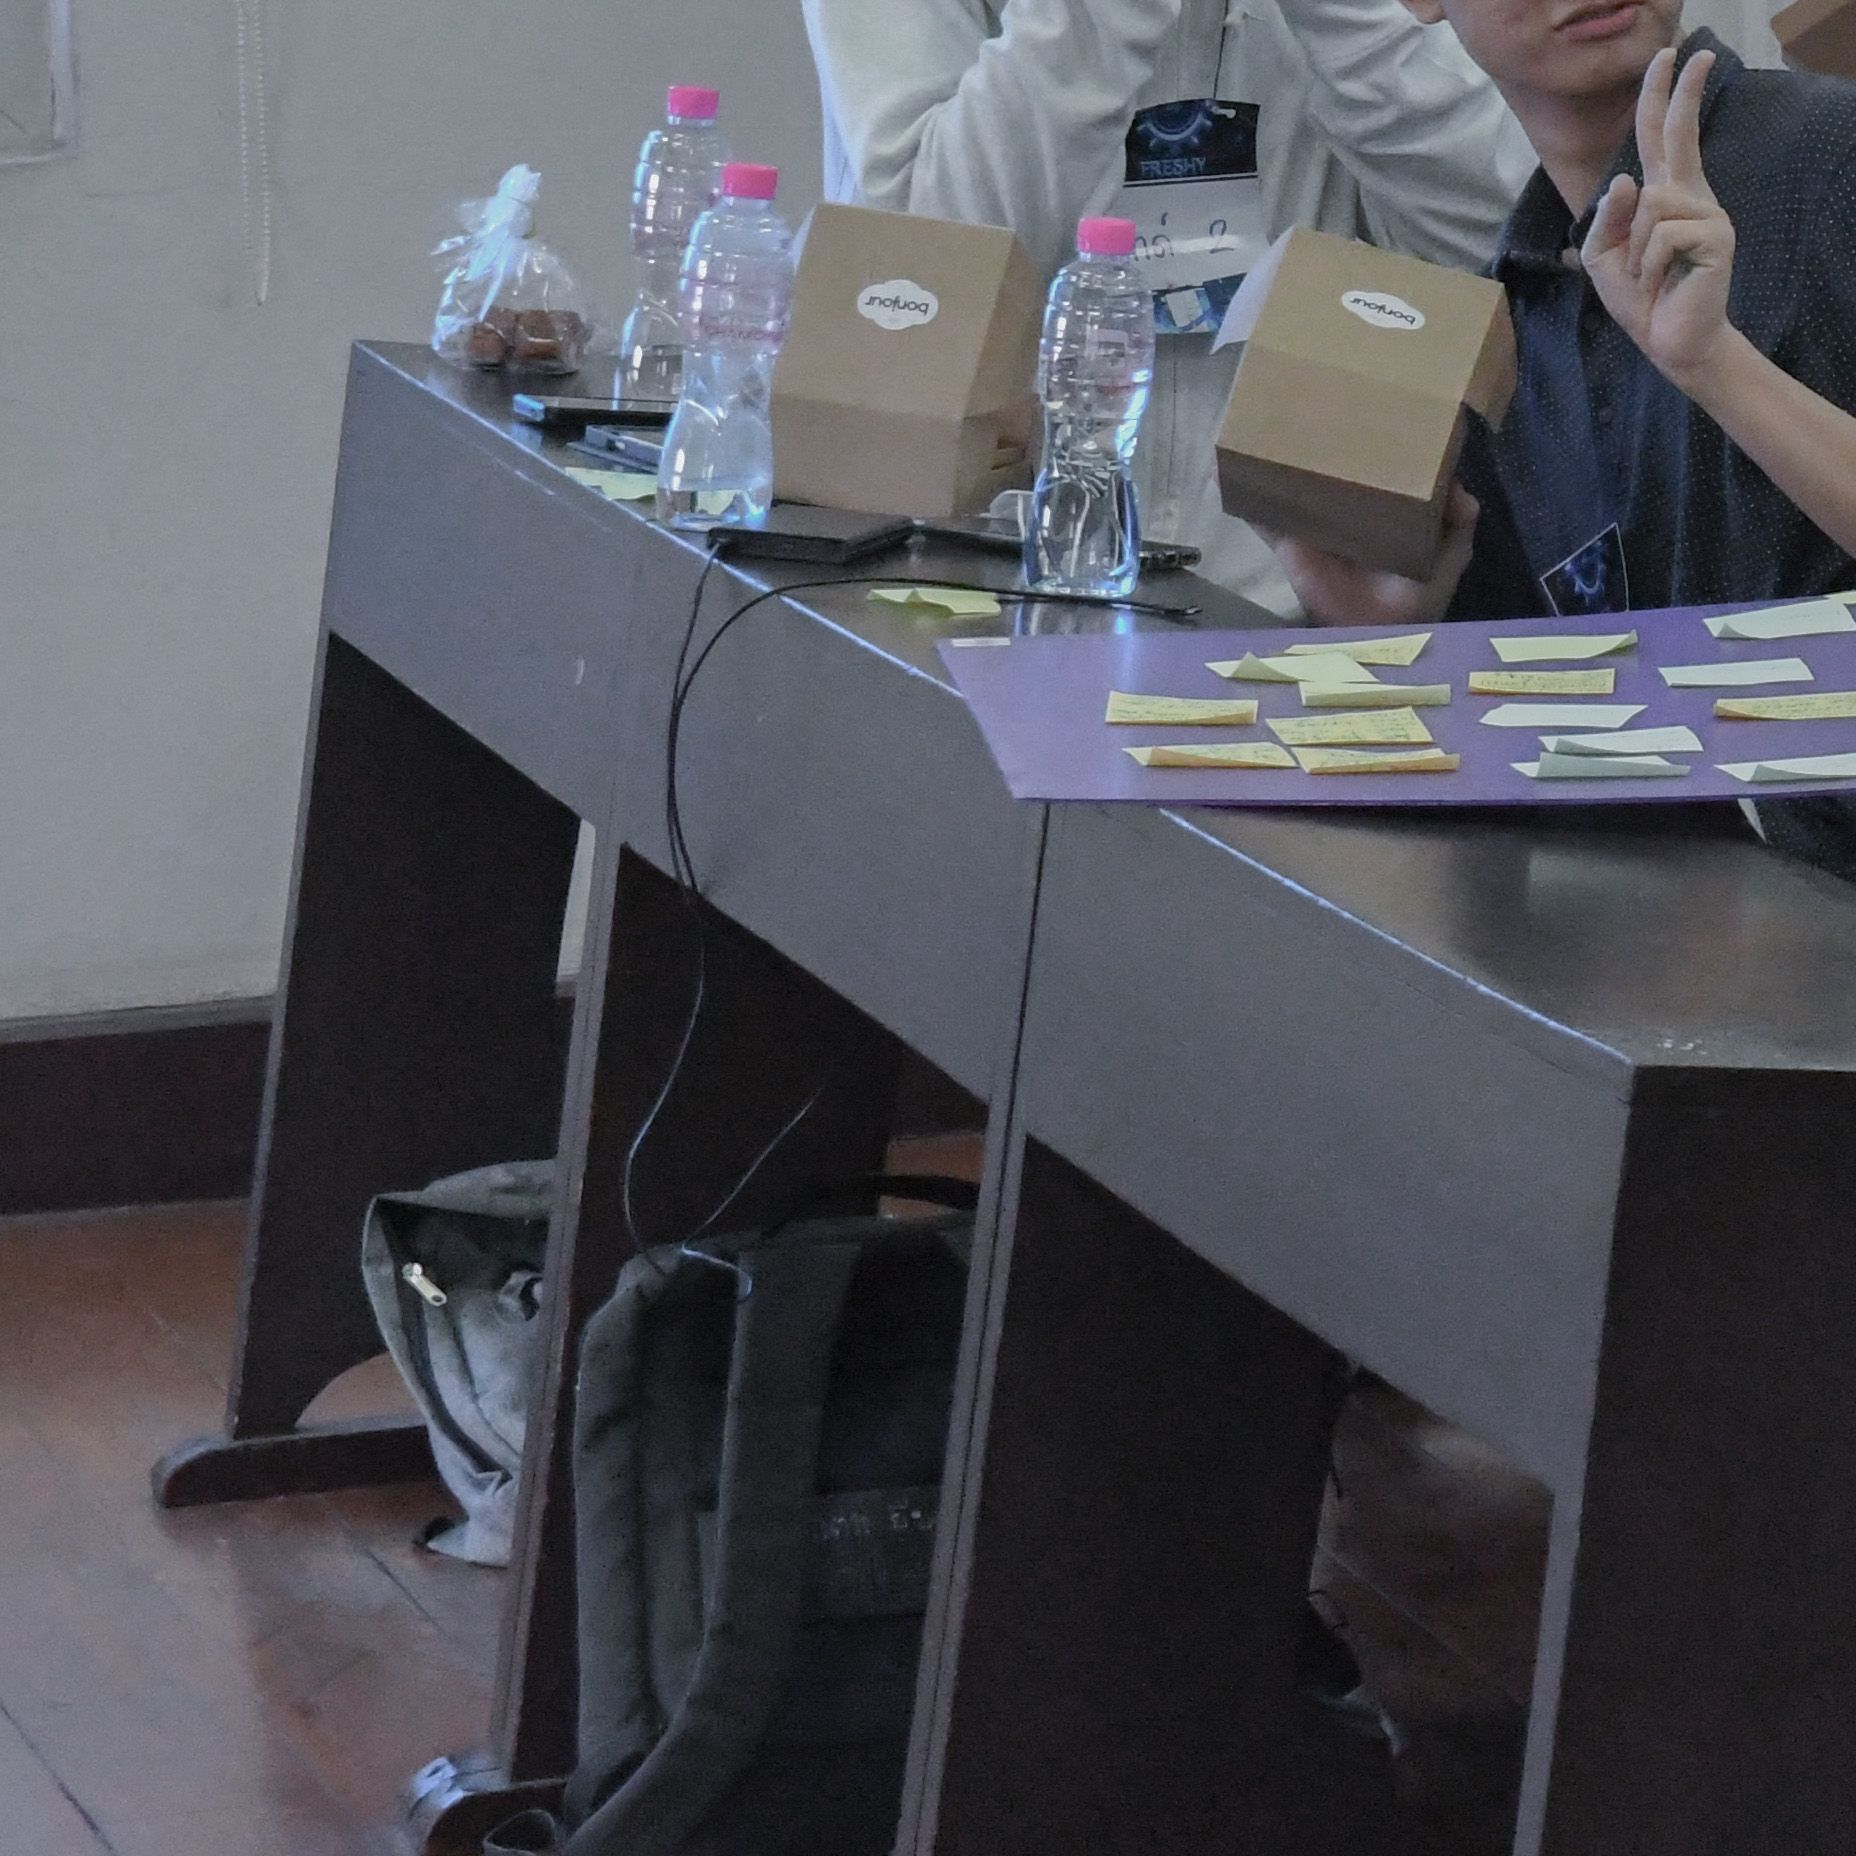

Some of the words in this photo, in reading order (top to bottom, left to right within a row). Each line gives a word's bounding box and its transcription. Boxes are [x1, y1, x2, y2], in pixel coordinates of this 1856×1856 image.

[1140, 156, 1207, 178] FRESHY
[864, 294, 930, 316] bonjour
[1350, 297, 1417, 326] bonjour
